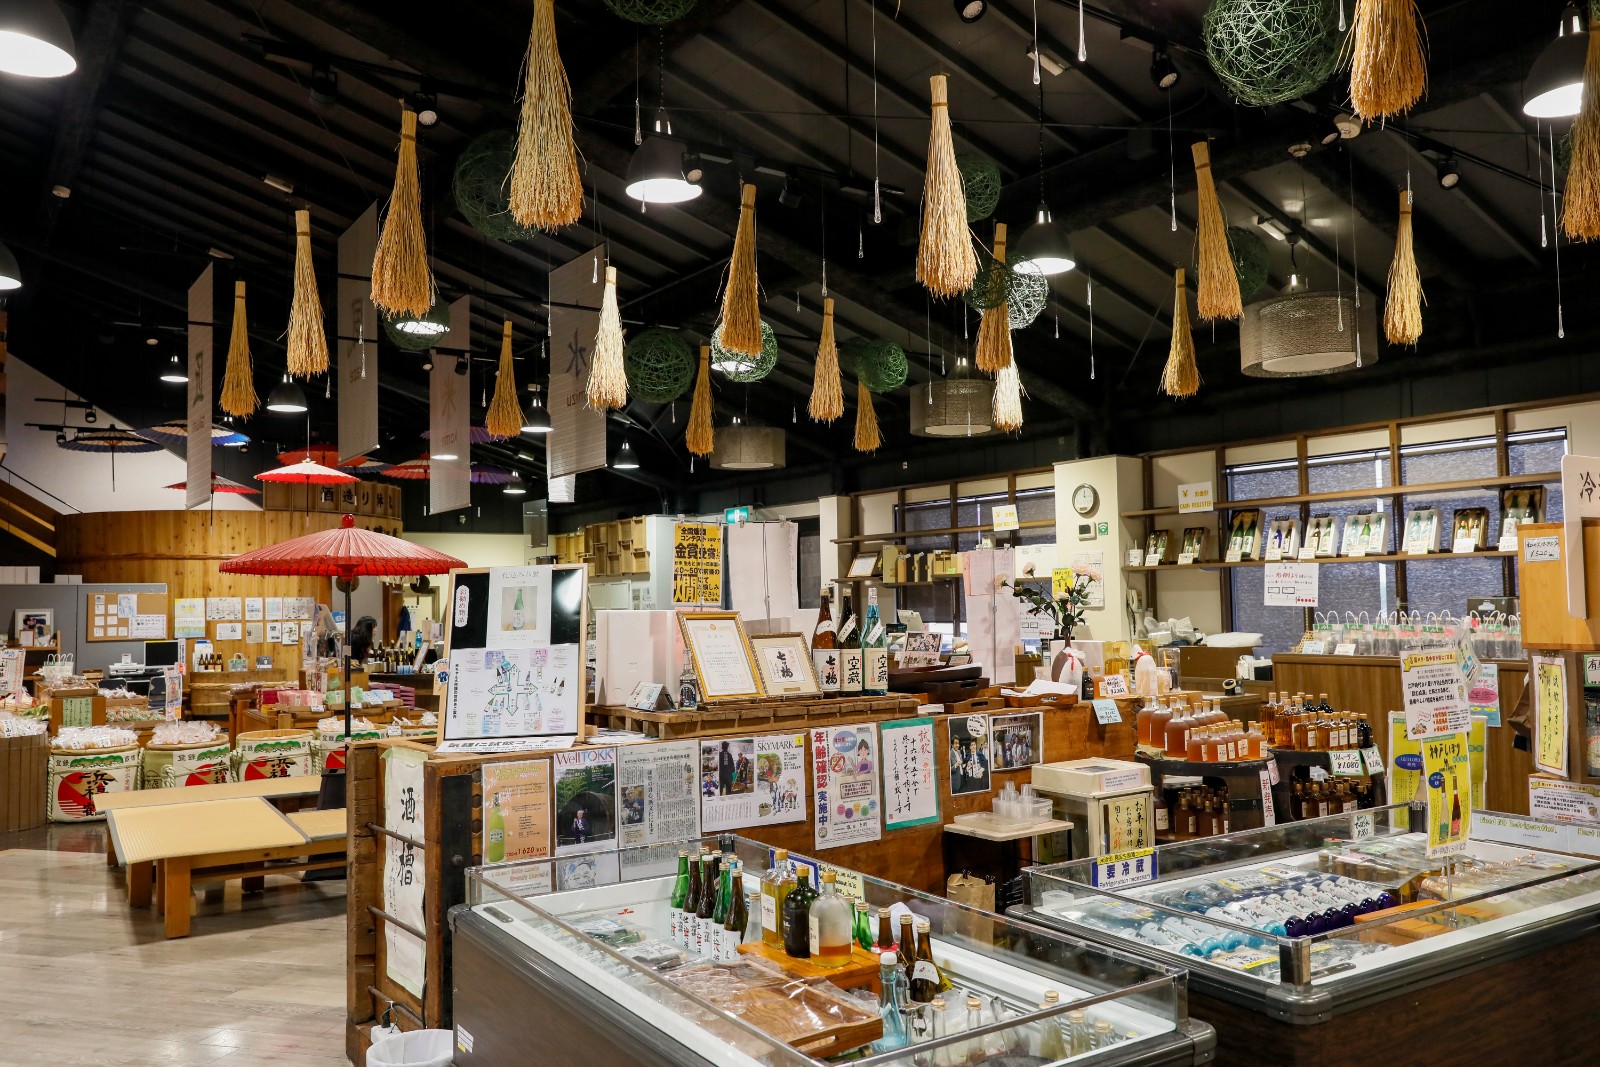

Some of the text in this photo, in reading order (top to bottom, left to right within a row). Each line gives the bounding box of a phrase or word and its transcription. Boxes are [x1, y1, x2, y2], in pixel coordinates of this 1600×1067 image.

[1580, 470, 1600, 503] 冷
[757, 740, 794, 751] SKYMARK
[814, 731, 828, 826] 年齢確認 実施中
[1106, 858, 1145, 880] 要冷蔵
